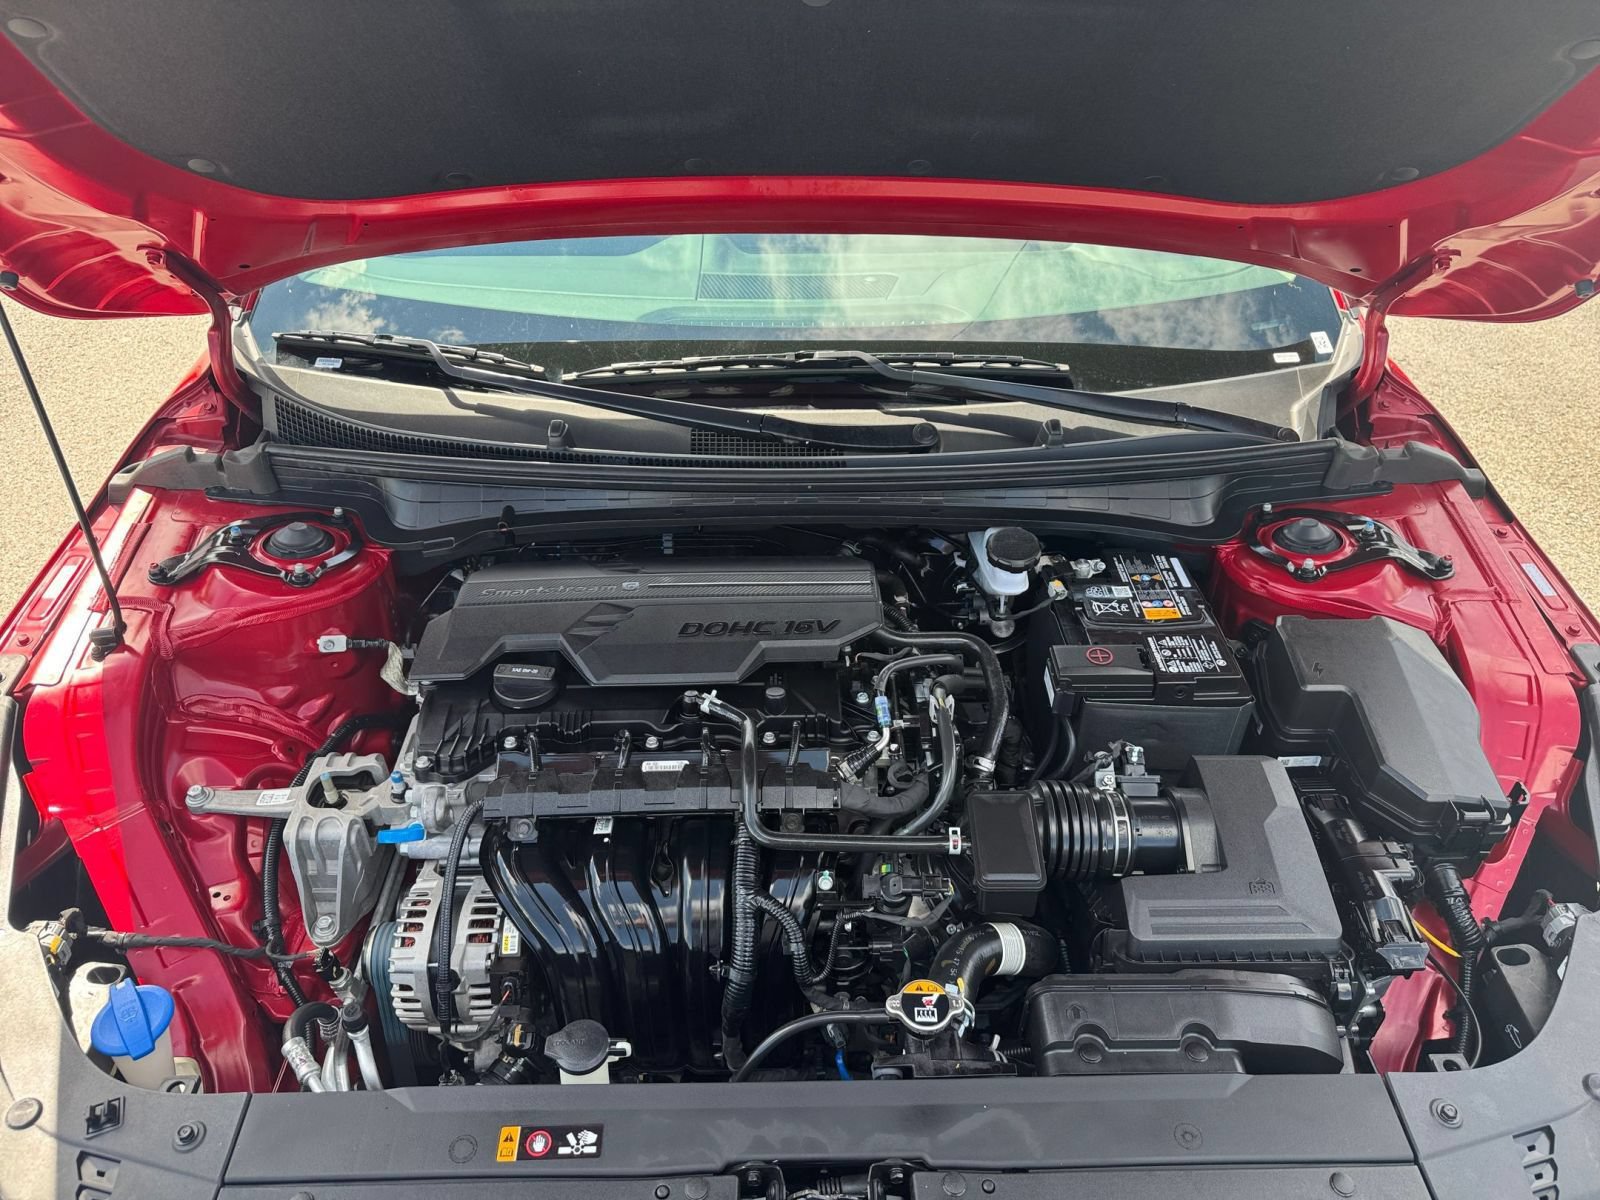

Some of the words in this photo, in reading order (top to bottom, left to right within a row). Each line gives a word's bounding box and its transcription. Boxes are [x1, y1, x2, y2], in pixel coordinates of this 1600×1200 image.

[480, 585, 617, 597] Smartstream
[678, 621, 776, 637] DOHC
[783, 619, 841, 635] 16V
